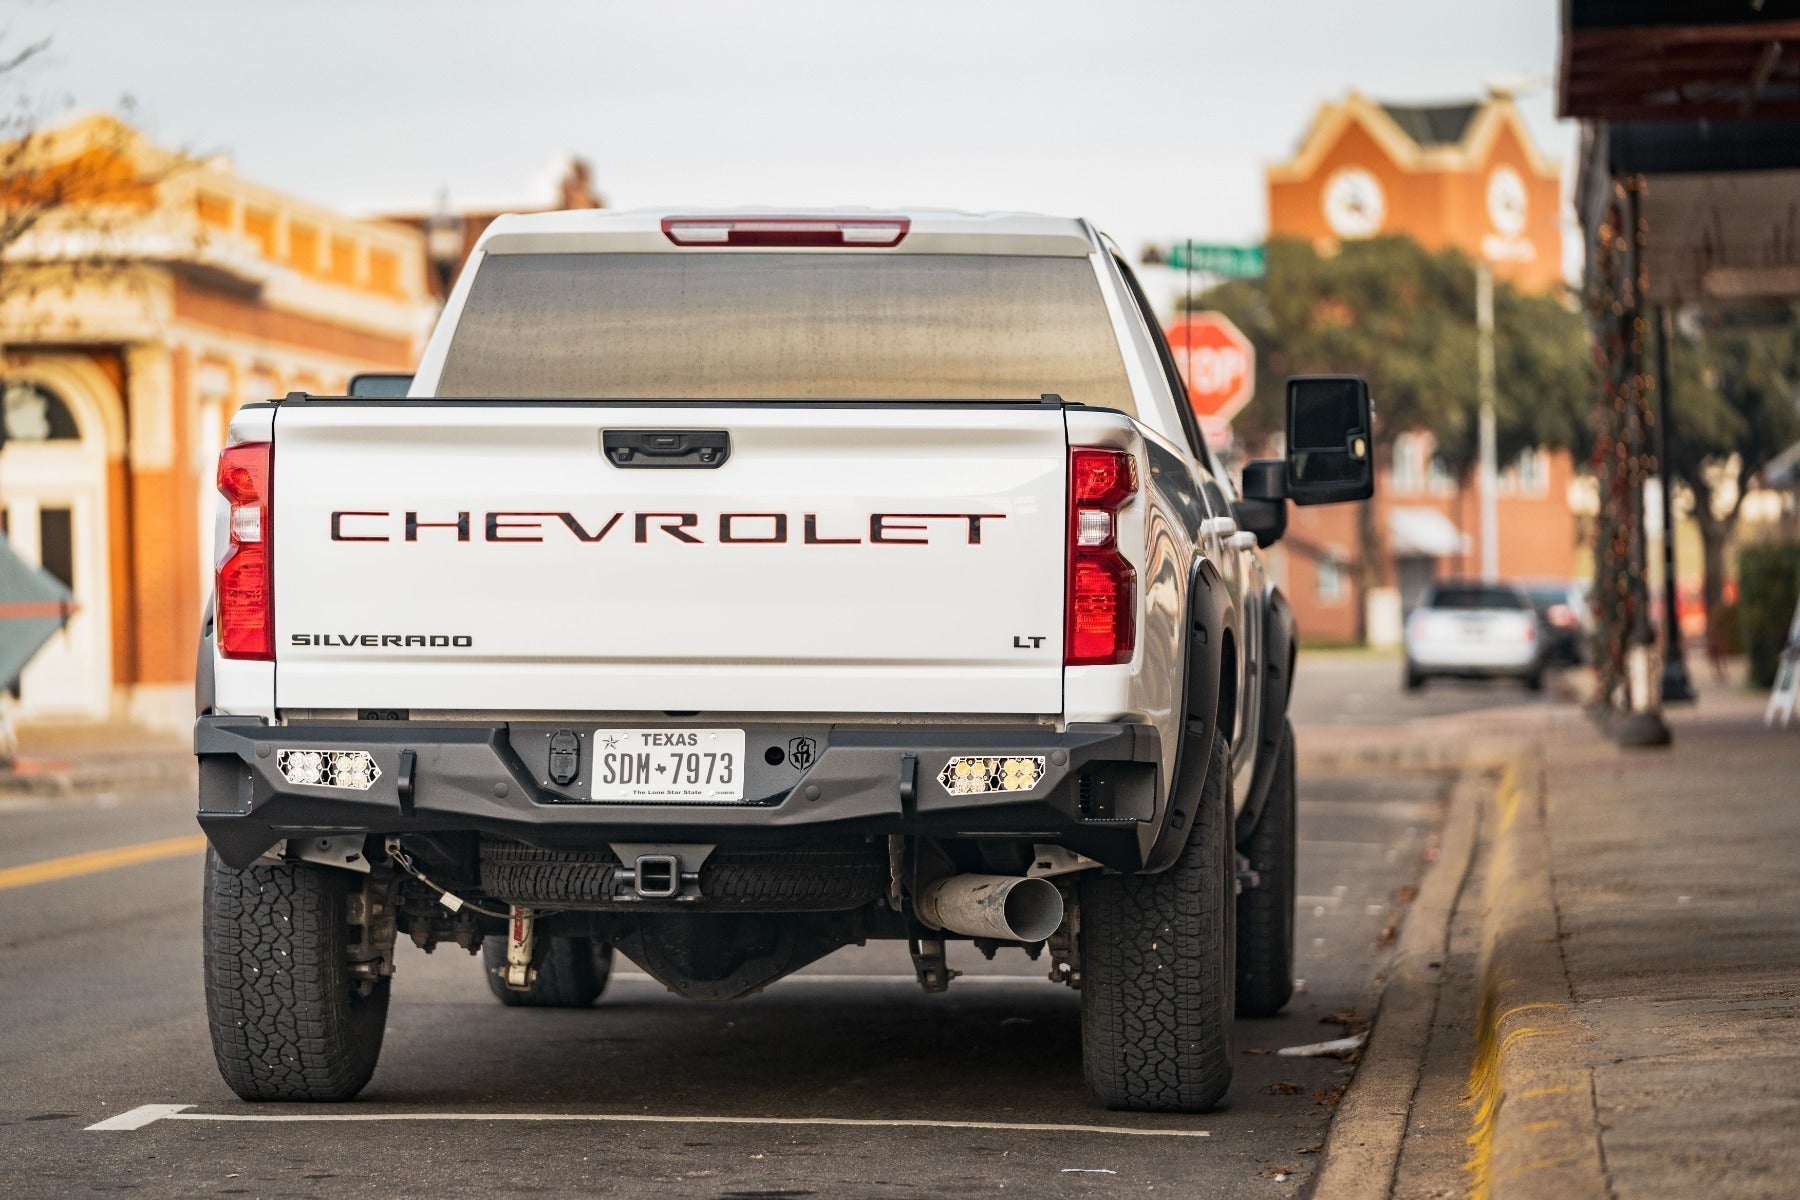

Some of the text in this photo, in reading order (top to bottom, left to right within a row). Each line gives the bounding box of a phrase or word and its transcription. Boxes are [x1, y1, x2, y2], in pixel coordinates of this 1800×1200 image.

[1171, 345, 1246, 396] TOP
[330, 511, 1007, 545] CHEVROLET
[291, 633, 473, 648] SILVERADO
[1013, 635, 1047, 649] LT
[641, 733, 698, 747] TEXAS
